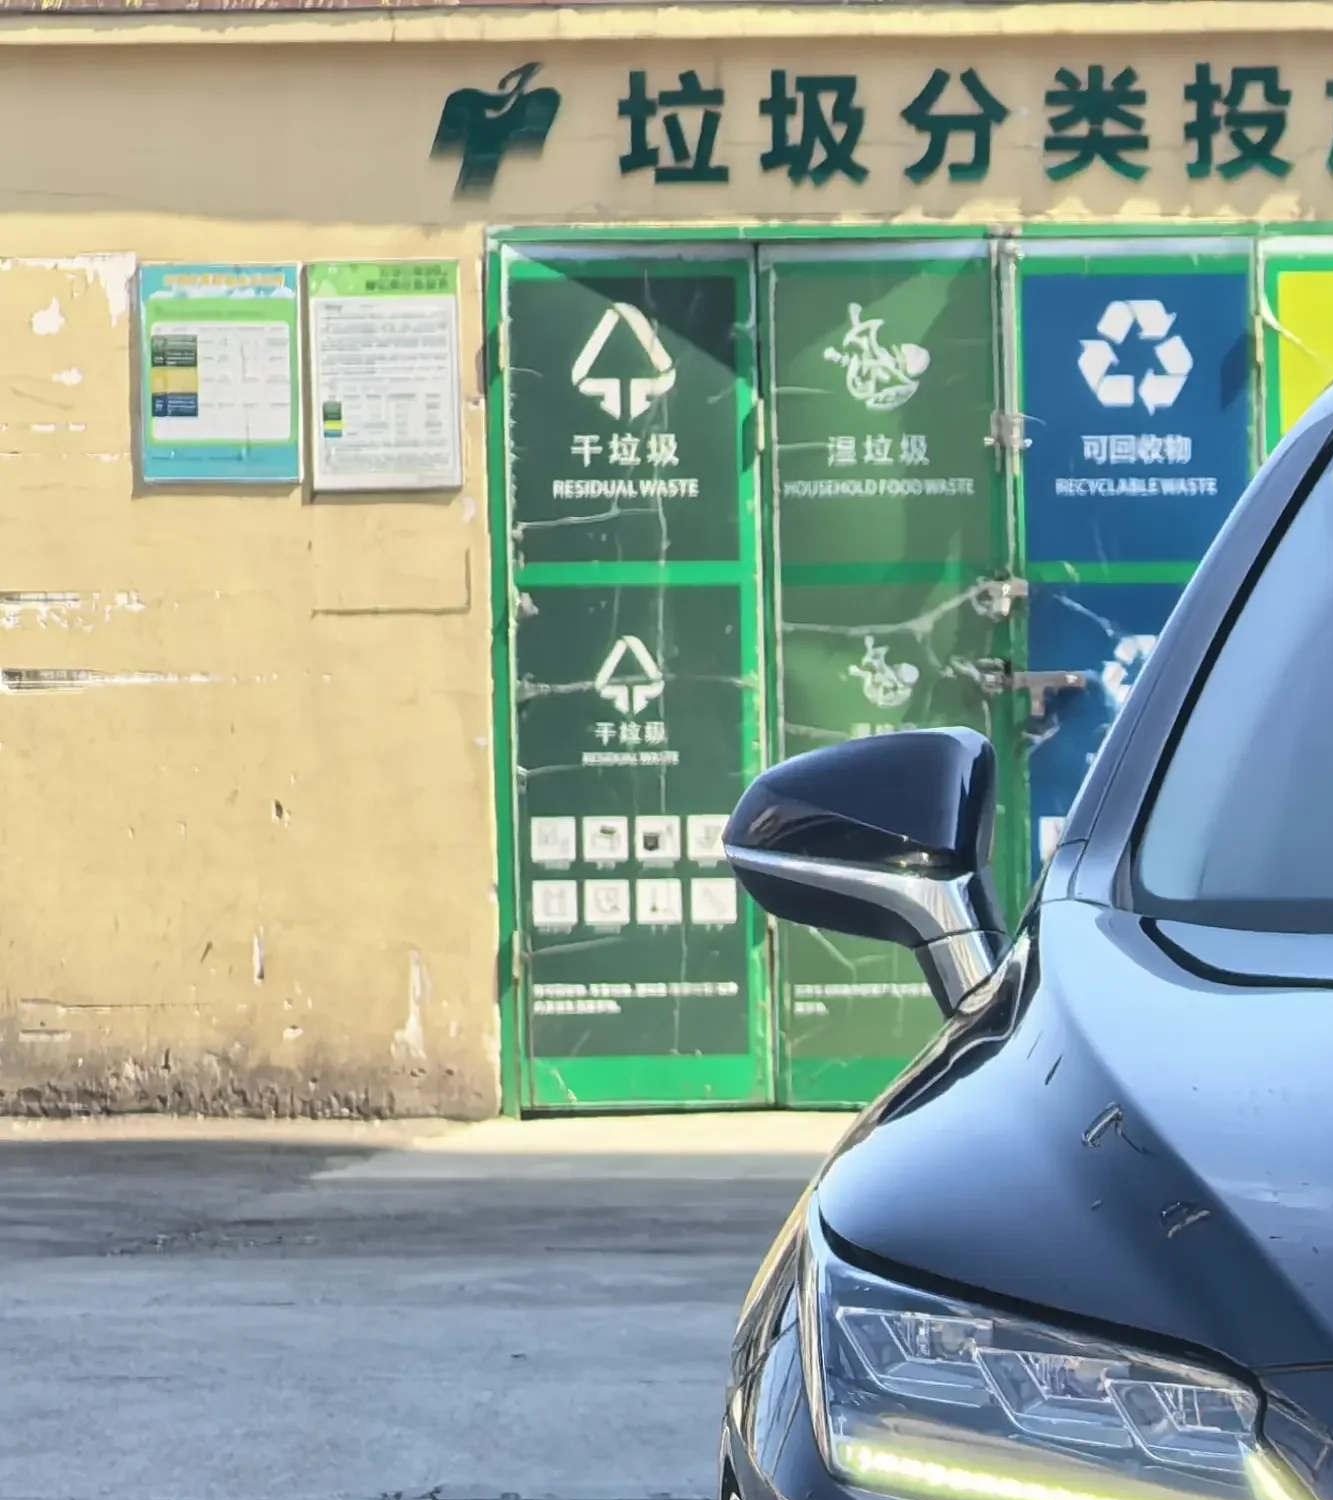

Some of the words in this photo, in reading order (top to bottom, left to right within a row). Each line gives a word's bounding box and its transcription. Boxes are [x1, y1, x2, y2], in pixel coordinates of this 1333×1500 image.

[570, 432, 680, 468] 干垃圾
[552, 479, 638, 499] RESIDUAL
[639, 478, 700, 498] WASTE
